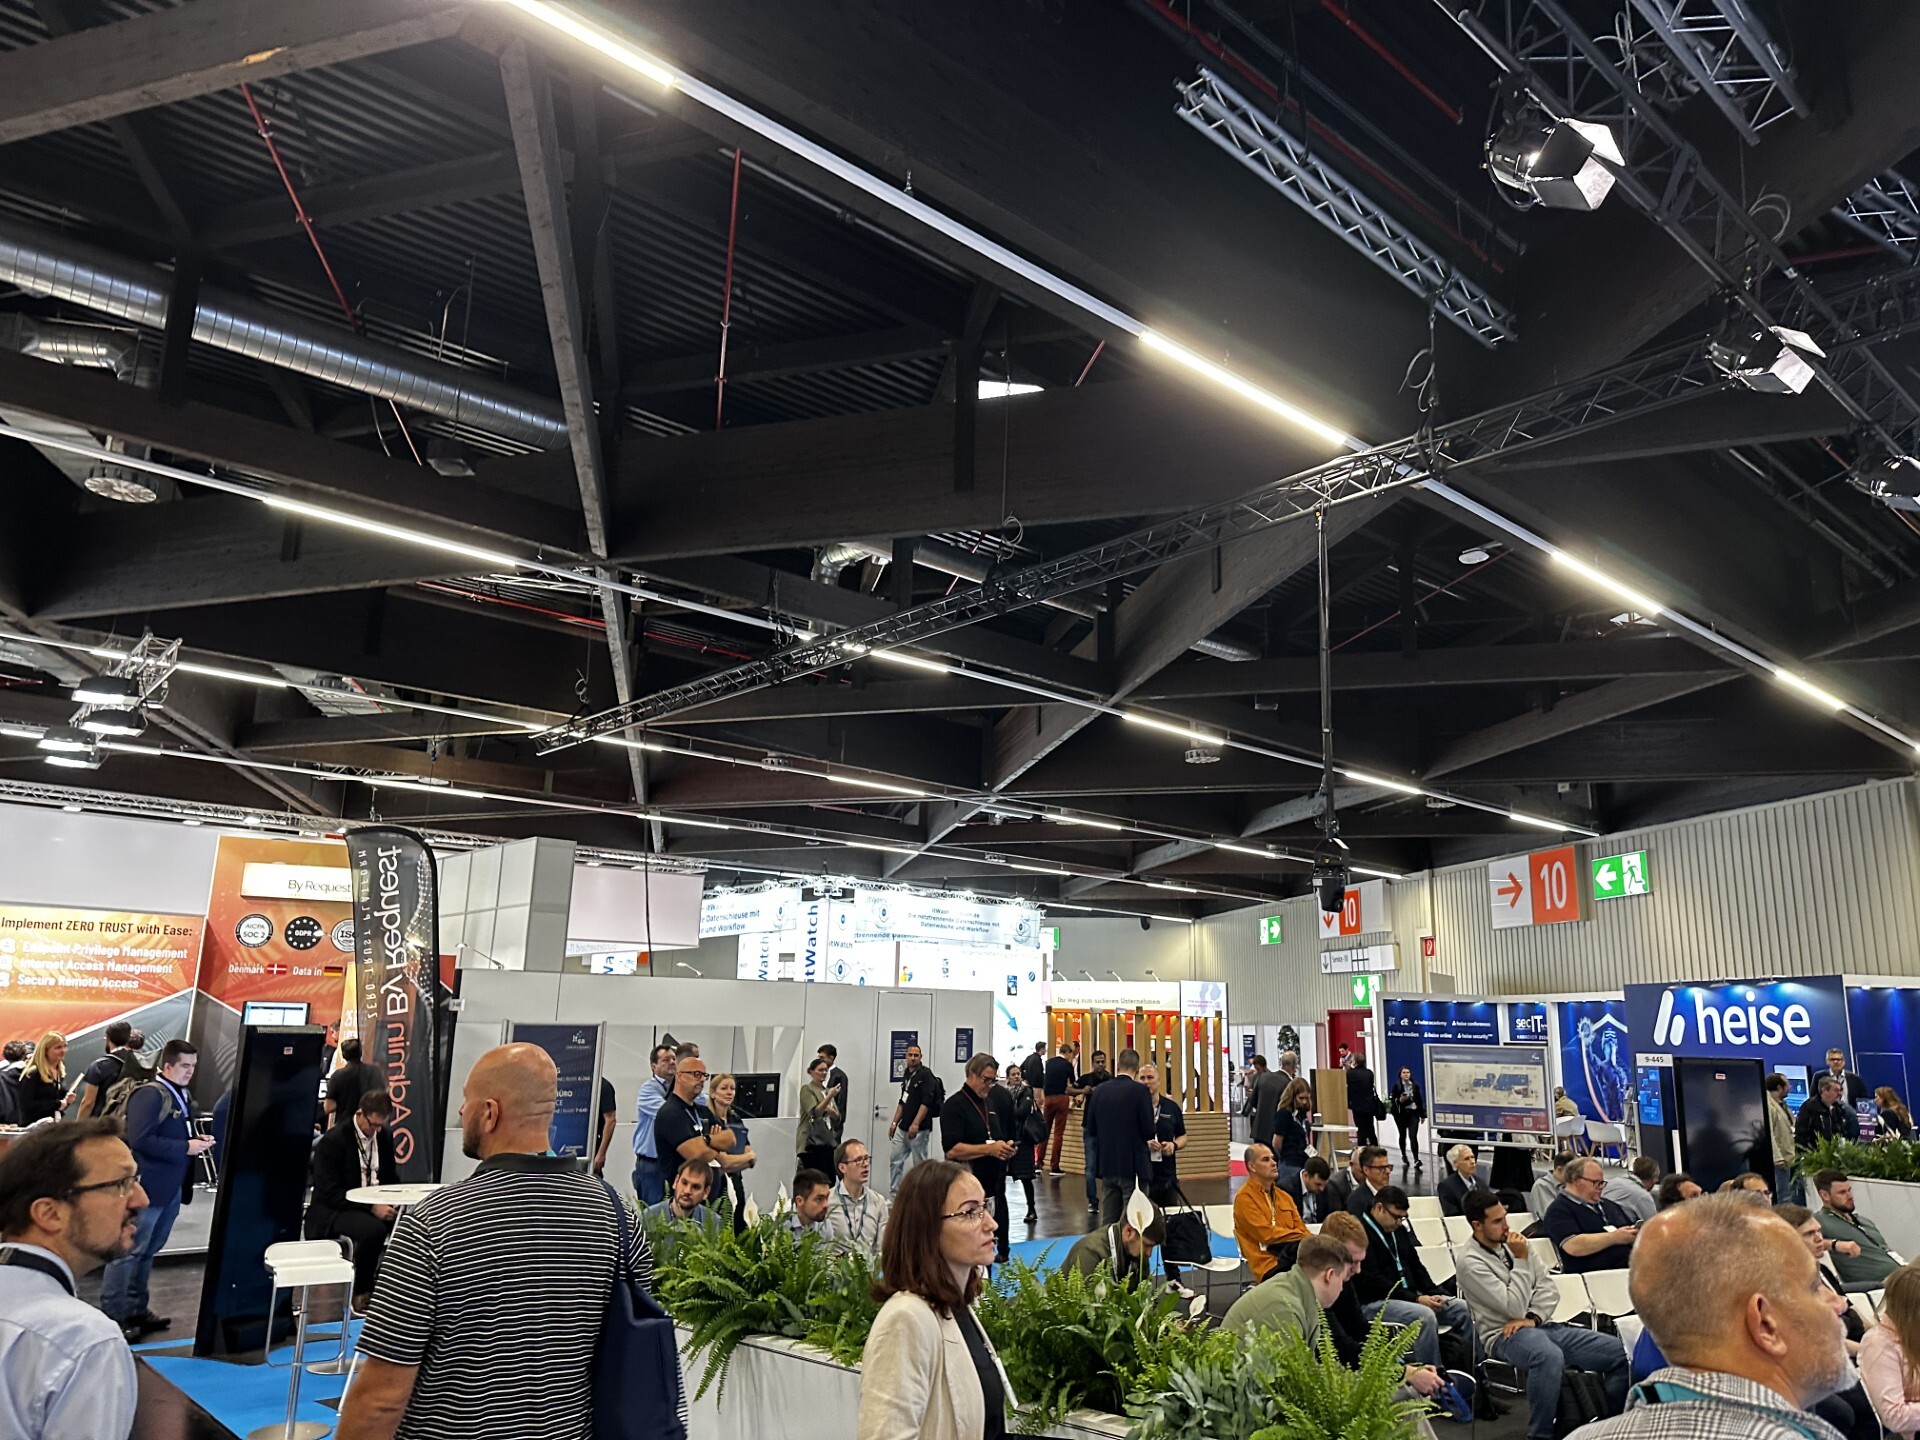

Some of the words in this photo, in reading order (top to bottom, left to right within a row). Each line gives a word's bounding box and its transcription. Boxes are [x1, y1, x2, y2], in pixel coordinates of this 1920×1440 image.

[288, 879, 303, 892] By
[305, 880, 351, 893] Request
[1539, 860, 1567, 910] 10
[749, 909, 760, 918] mit
[1344, 897, 1356, 928] 10
[1, 917, 63, 931] Implement
[66, 920, 94, 932] ZERO
[99, 922, 133, 934] TRUST
[137, 925, 160, 935] with
[163, 925, 193, 936] Ease:
[294, 929, 312, 937] GDPR
[805, 904, 818, 982] itWatch
[73, 943, 120, 958] Privilege
[122, 945, 188, 960] Management
[66, 959, 104, 971] Access
[107, 960, 173, 975] Management
[228, 963, 265, 974] Denmark
[293, 966, 311, 975] Data
[314, 967, 322, 976] in
[17, 973, 56, 985] Secure
[58, 975, 100, 987] Remote
[101, 977, 139, 988] Access
[1695, 990, 1811, 1046] heise
